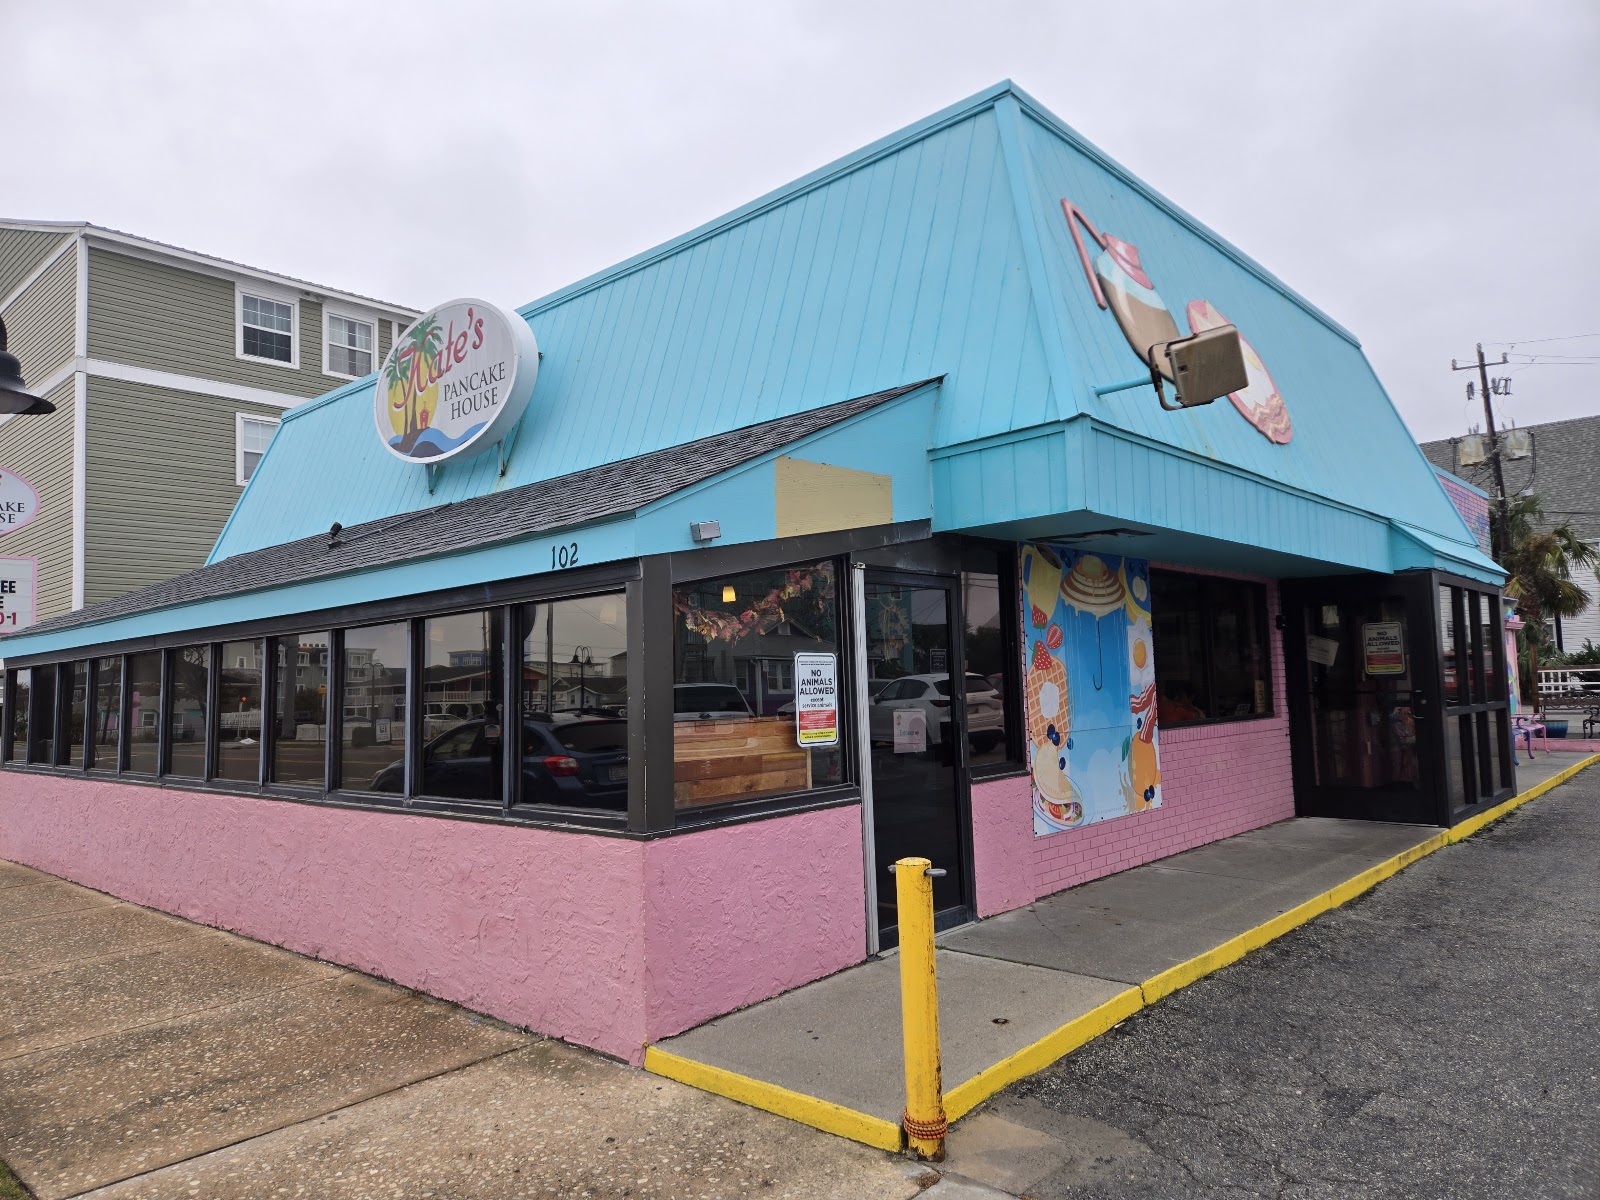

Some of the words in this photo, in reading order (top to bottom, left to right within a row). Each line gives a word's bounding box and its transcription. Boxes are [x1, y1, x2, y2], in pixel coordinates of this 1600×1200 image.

[443, 361, 506, 402] PANCAKE
[450, 386, 498, 420] HOUSE
[551, 542, 579, 570] 102
[811, 669, 822, 677] NO
[799, 687, 835, 696] ALLOWED
[800, 678, 833, 687] ANIMALS
